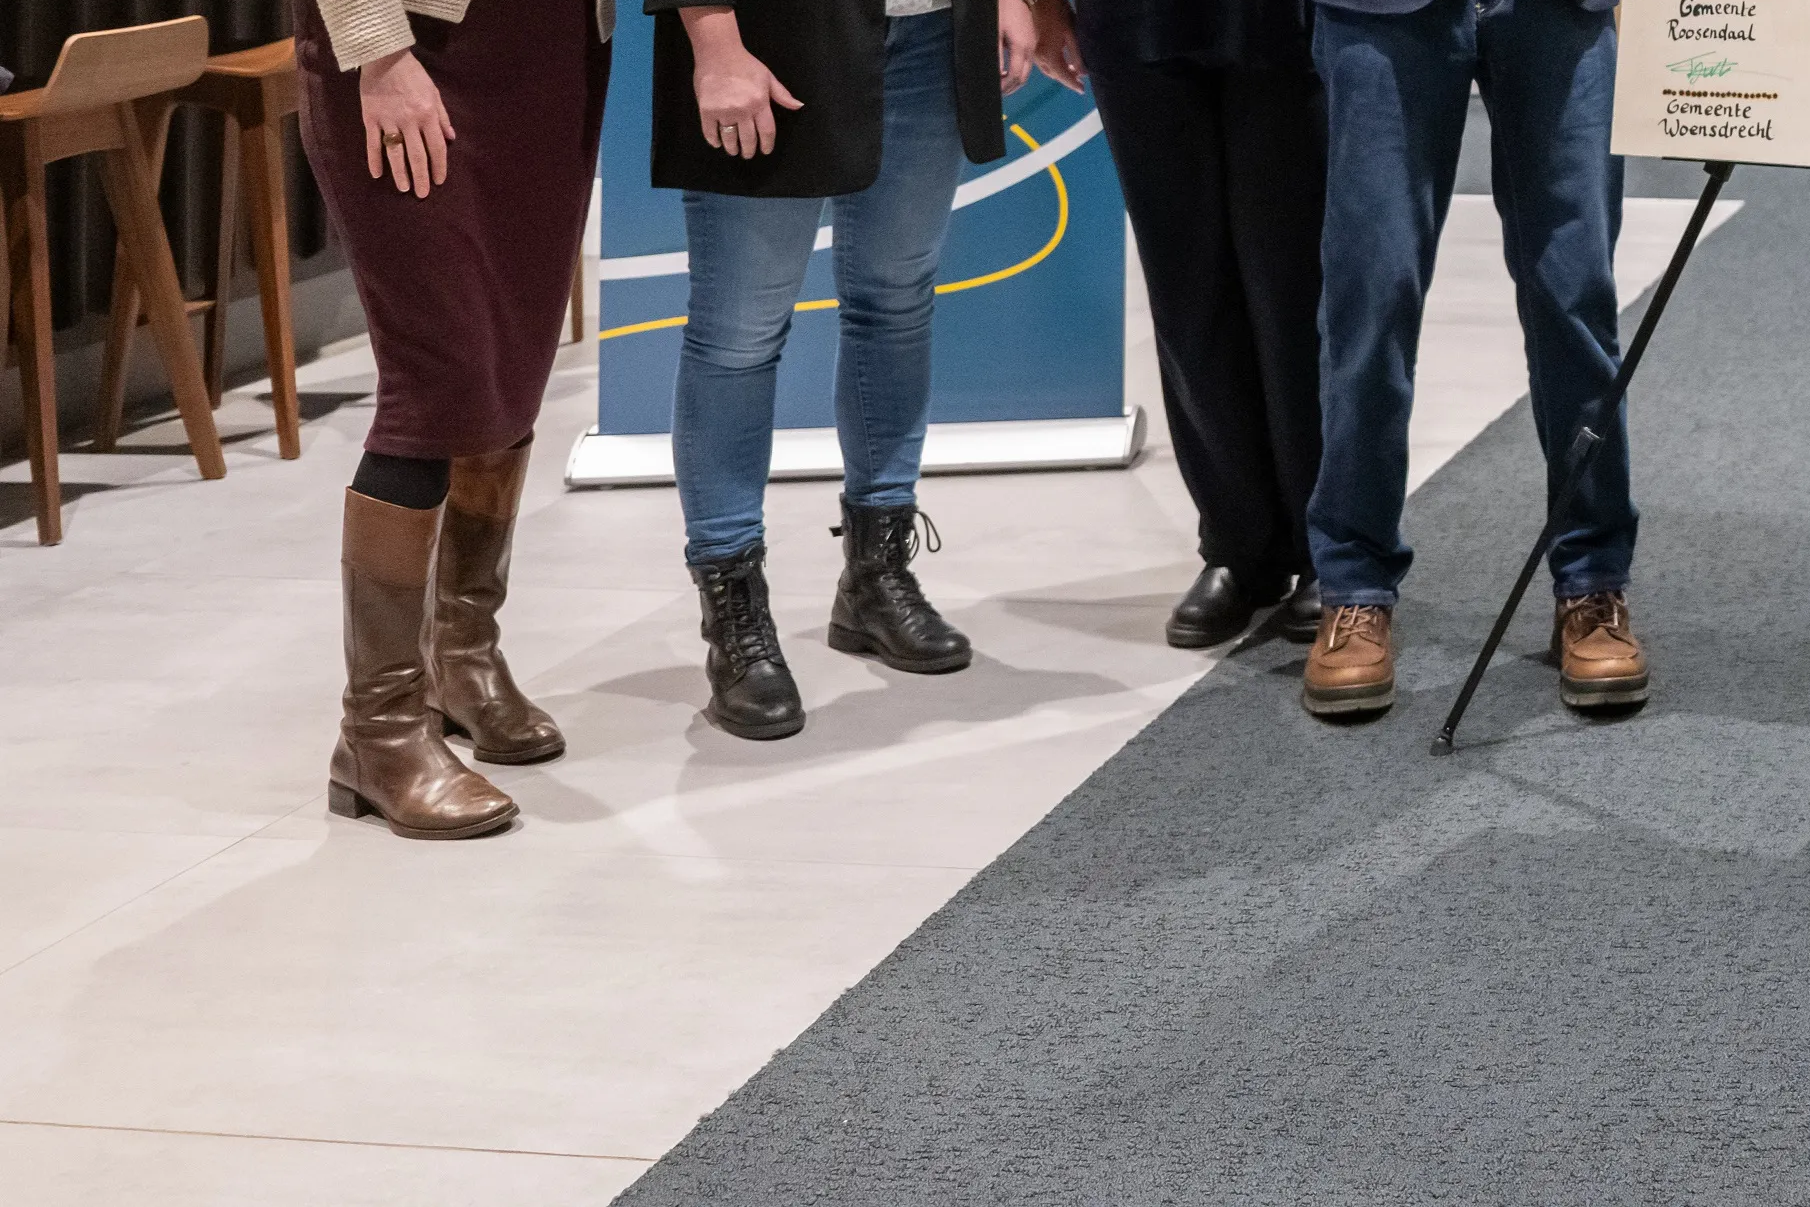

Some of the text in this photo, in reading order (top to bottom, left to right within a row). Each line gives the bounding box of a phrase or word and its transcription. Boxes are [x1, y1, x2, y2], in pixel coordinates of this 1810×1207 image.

[1667, 19, 1756, 41] Roosendaal
[1666, 99, 1752, 119] Gemeente
[1658, 118, 1774, 140] Woensdrecht
